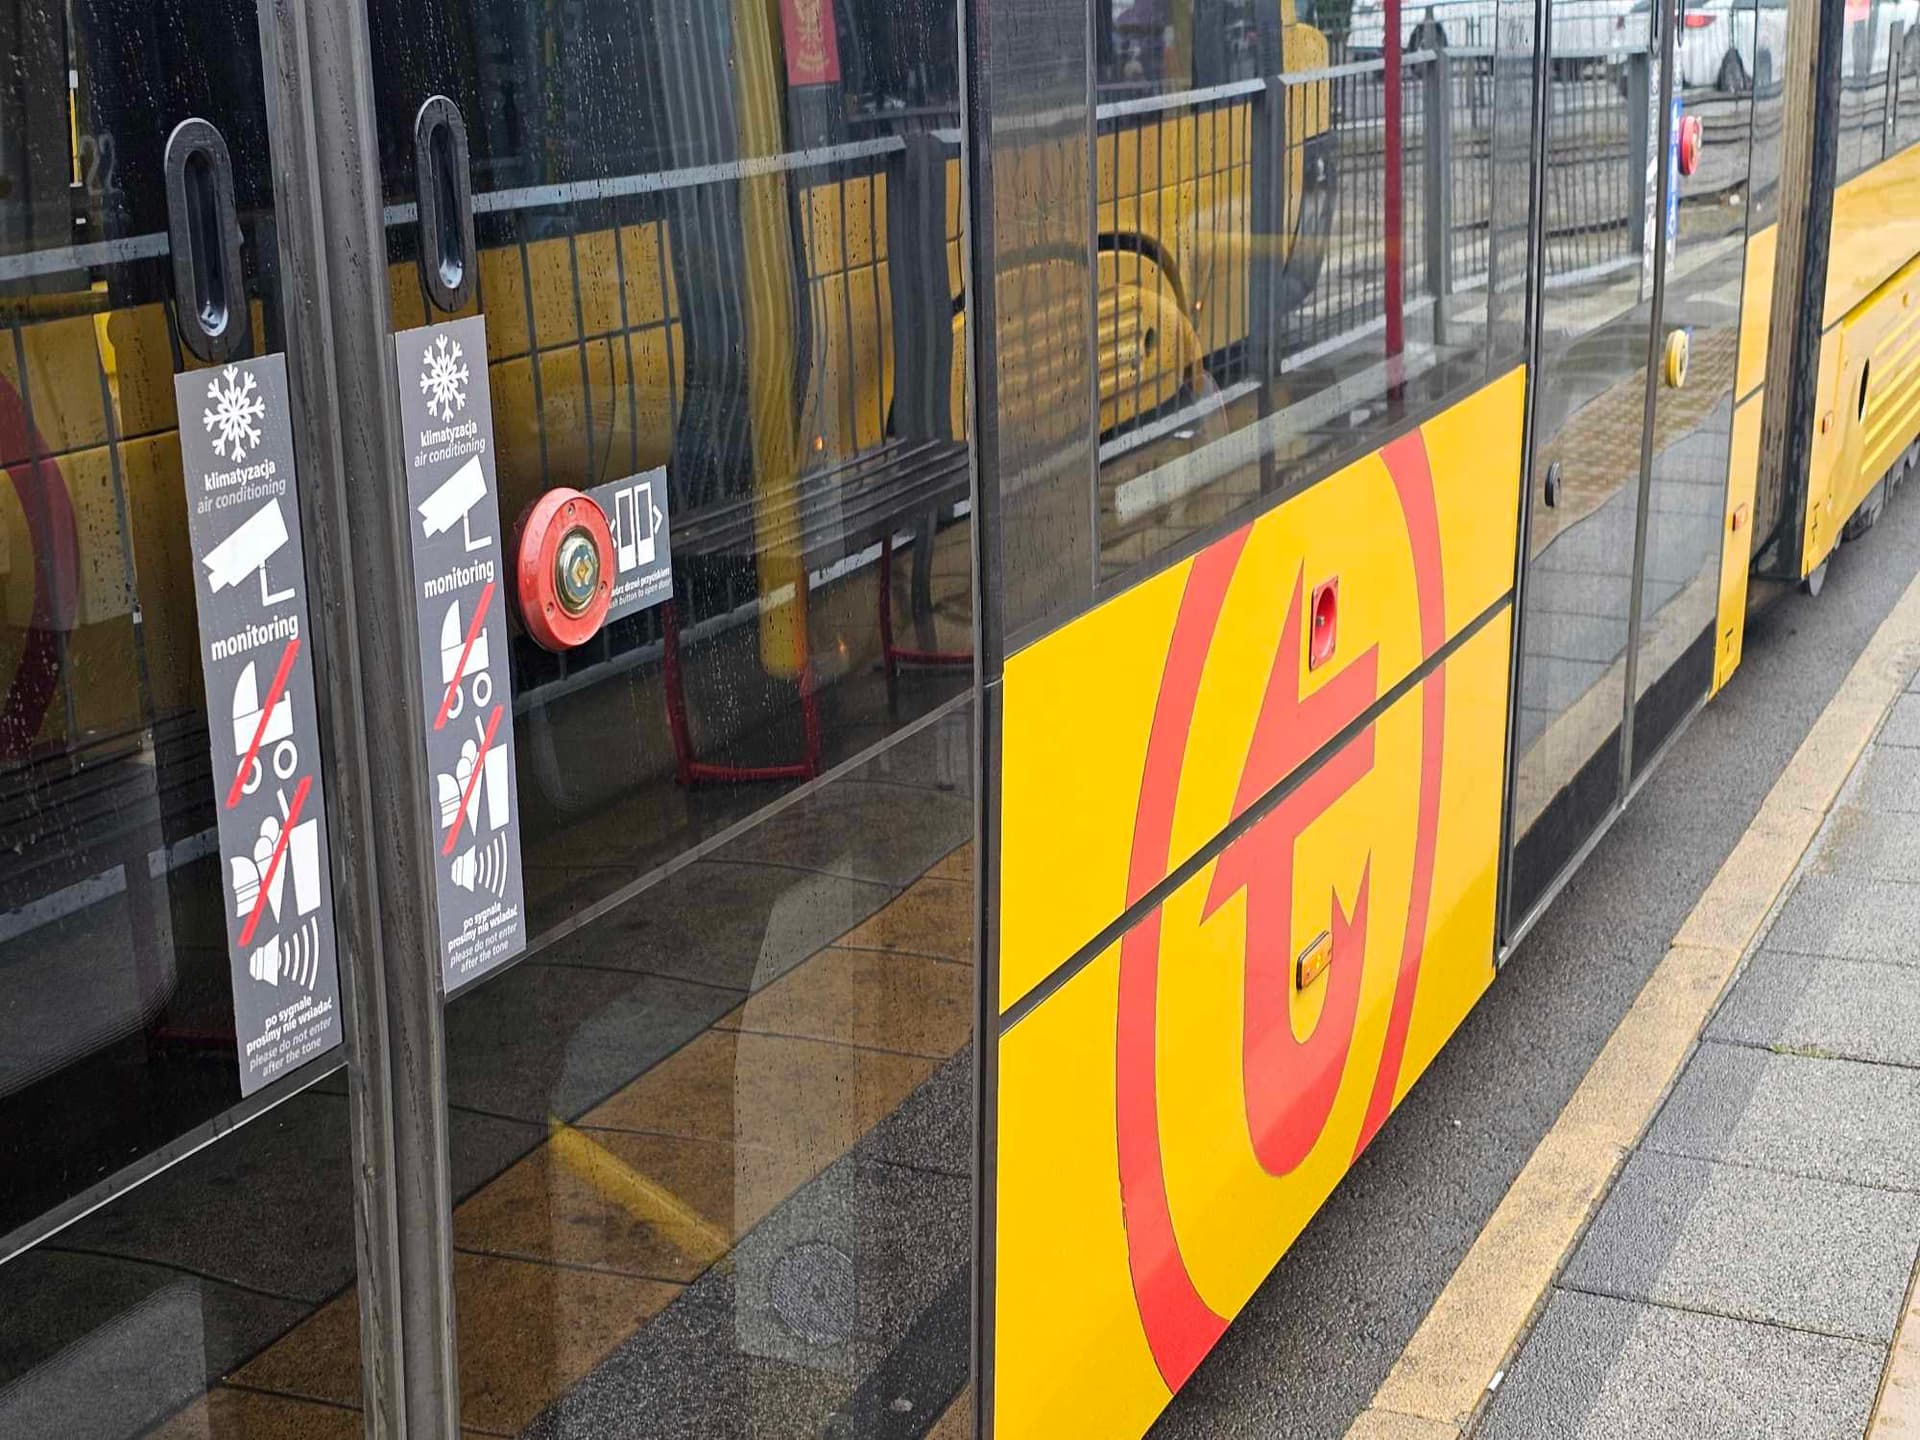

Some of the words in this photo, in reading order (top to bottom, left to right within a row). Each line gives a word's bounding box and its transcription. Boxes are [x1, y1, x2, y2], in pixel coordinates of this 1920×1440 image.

[420, 419, 477, 447] klimatyzacja
[414, 450, 427, 467] air
[429, 438, 486, 463] conditioning
[204, 458, 276, 491] klimatyzacja
[197, 496, 213, 514] air
[215, 478, 286, 508] conditioning
[424, 559, 494, 598] monitoring
[211, 615, 299, 661] monitoring
[464, 917, 474, 934] po
[475, 939, 484, 953] do
[485, 932, 497, 947] not
[480, 949, 491, 964] the
[492, 940, 509, 956] tone
[246, 1027, 281, 1056] prosimy
[283, 1016, 297, 1034] nie
[298, 996, 332, 1025] wsiadać
[265, 1014, 277, 1031] po
[278, 995, 312, 1023] sygnale
[249, 1047, 278, 1073] please
[279, 1039, 291, 1053] do
[292, 1029, 308, 1046] not
[309, 1016, 332, 1036] enter
[263, 1057, 284, 1077] after
[286, 1047, 300, 1064] the
[301, 1037, 322, 1055] tone
